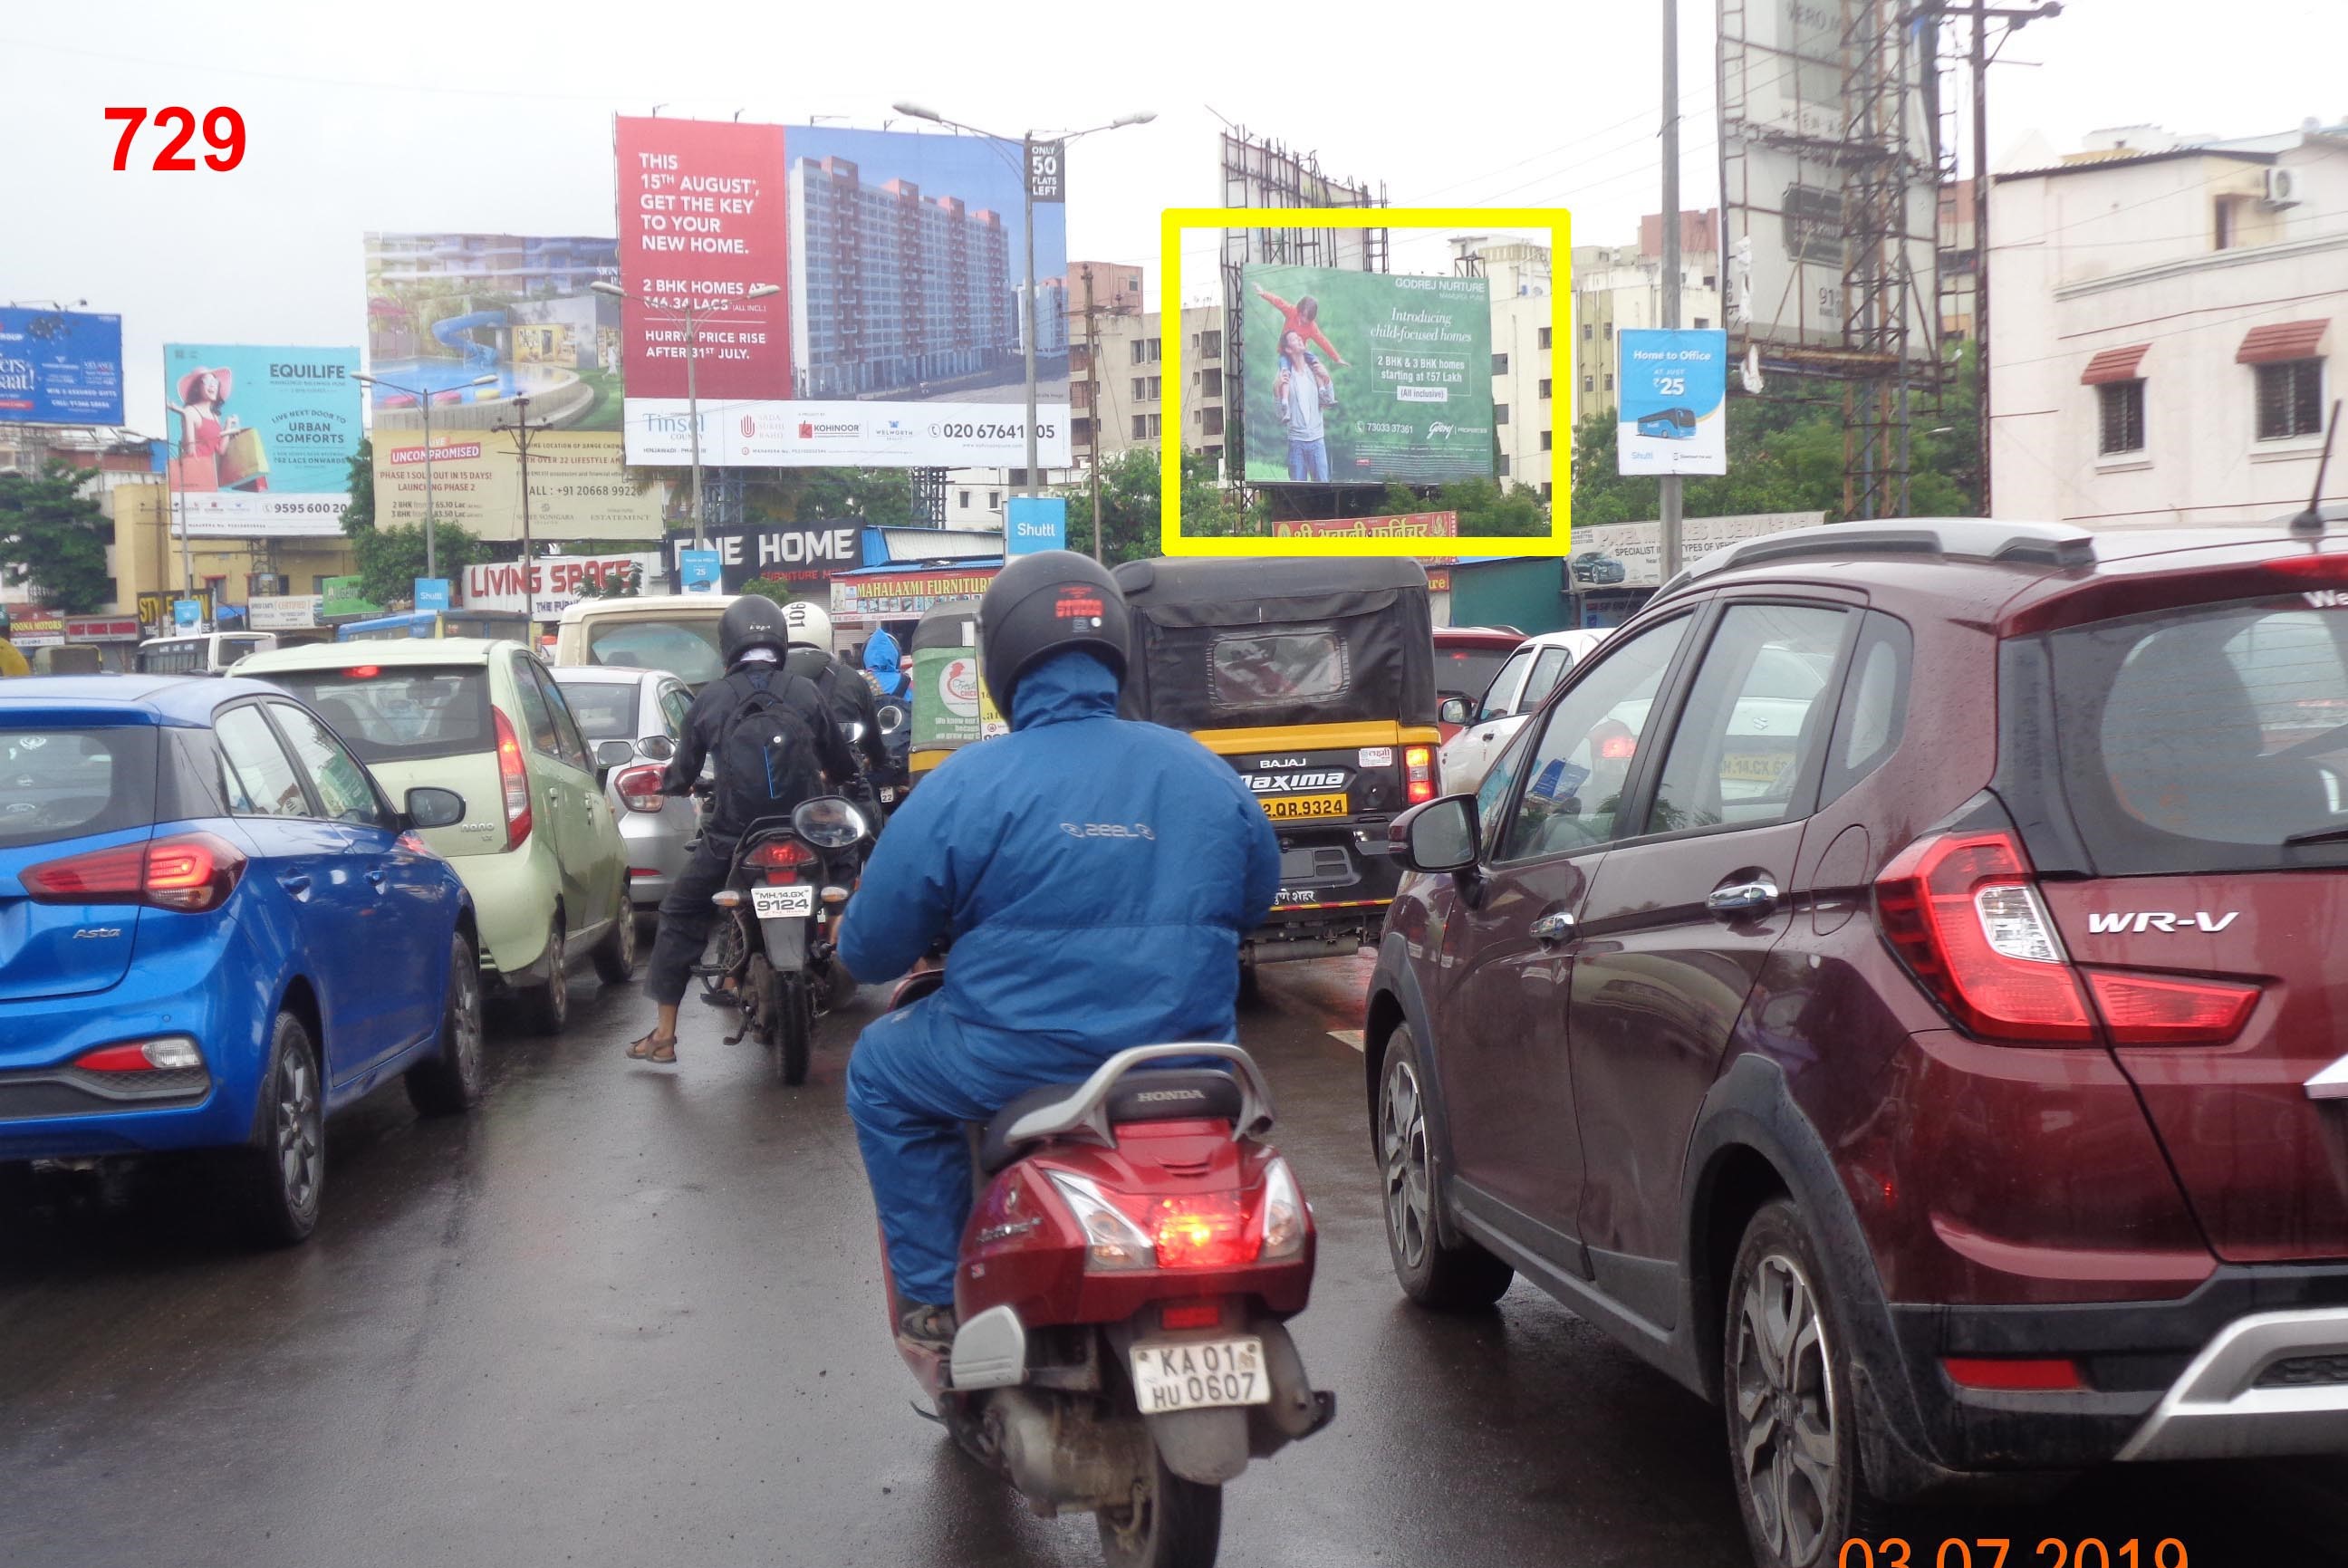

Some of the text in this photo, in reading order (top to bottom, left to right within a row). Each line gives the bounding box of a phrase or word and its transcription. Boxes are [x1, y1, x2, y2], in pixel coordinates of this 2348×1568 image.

[1032, 146, 1055, 155] ONLY
[638, 152, 678, 170] THIS
[1033, 156, 1057, 175] 50
[640, 174, 675, 189] 15TH
[1033, 176, 1057, 185] FLATS
[1033, 186, 1057, 196] LEFT
[640, 194, 754, 214] GET THE KEY
[640, 215, 721, 233] TO YOUR
[641, 236, 749, 255] NEW HOME.
[643, 279, 652, 292] 2
[656, 279, 687, 293] BHK
[691, 281, 744, 294] HOMES
[1395, 278, 1486, 293] GODREJ NURTURE
[1391, 307, 1453, 327] Introducing
[698, 332, 736, 343] PRICE
[739, 332, 766, 343] RISE
[1370, 323, 1472, 342] child-focused homes
[646, 347, 750, 360] AFTER 31ST JULY.
[1633, 350, 1711, 361] Home to Office
[1377, 356, 1465, 370] 2 BHK & 3 BHK homes
[269, 364, 345, 379] EQUILIFE
[1381, 370, 1463, 383] starting at ₹57 Lakh
[1400, 388, 1444, 399] (All inclusive)
[311, 409, 334, 419] DOOR
[288, 422, 331, 432] URBAN
[813, 424, 860, 432] KOHINOOR
[943, 424, 1055, 439] 020 6764105
[275, 434, 344, 444] COMFORTS
[380, 471, 405, 479] PHASE
[411, 472, 432, 480] SOL
[528, 486, 547, 495] ALL
[556, 486, 573, 495] +91
[577, 486, 609, 495] 20668
[274, 504, 331, 514] 9595 600
[1017, 523, 1055, 537] Shuttl
[674, 528, 856, 572] FNE HOME
[1615, 544, 1714, 556] SPECIALIST TYPES OF
[469, 562, 542, 597] LIVING
[857, 580, 924, 598] MAHALAXMI
[536, 601, 553, 612] THE
[789, 602, 806, 628] 901
[34, 620, 63, 631] MOTORS
[1259, 758, 1307, 769] BAJAJ
[759, 891, 804, 899] MH.14.GX
[756, 899, 809, 912] 9124
[2088, 911, 2240, 934] WR-V
[1138, 1090, 1206, 1102] HONDA
[1161, 1345, 1237, 1378] KA 01
[1151, 1372, 1256, 1409] HU 0607
